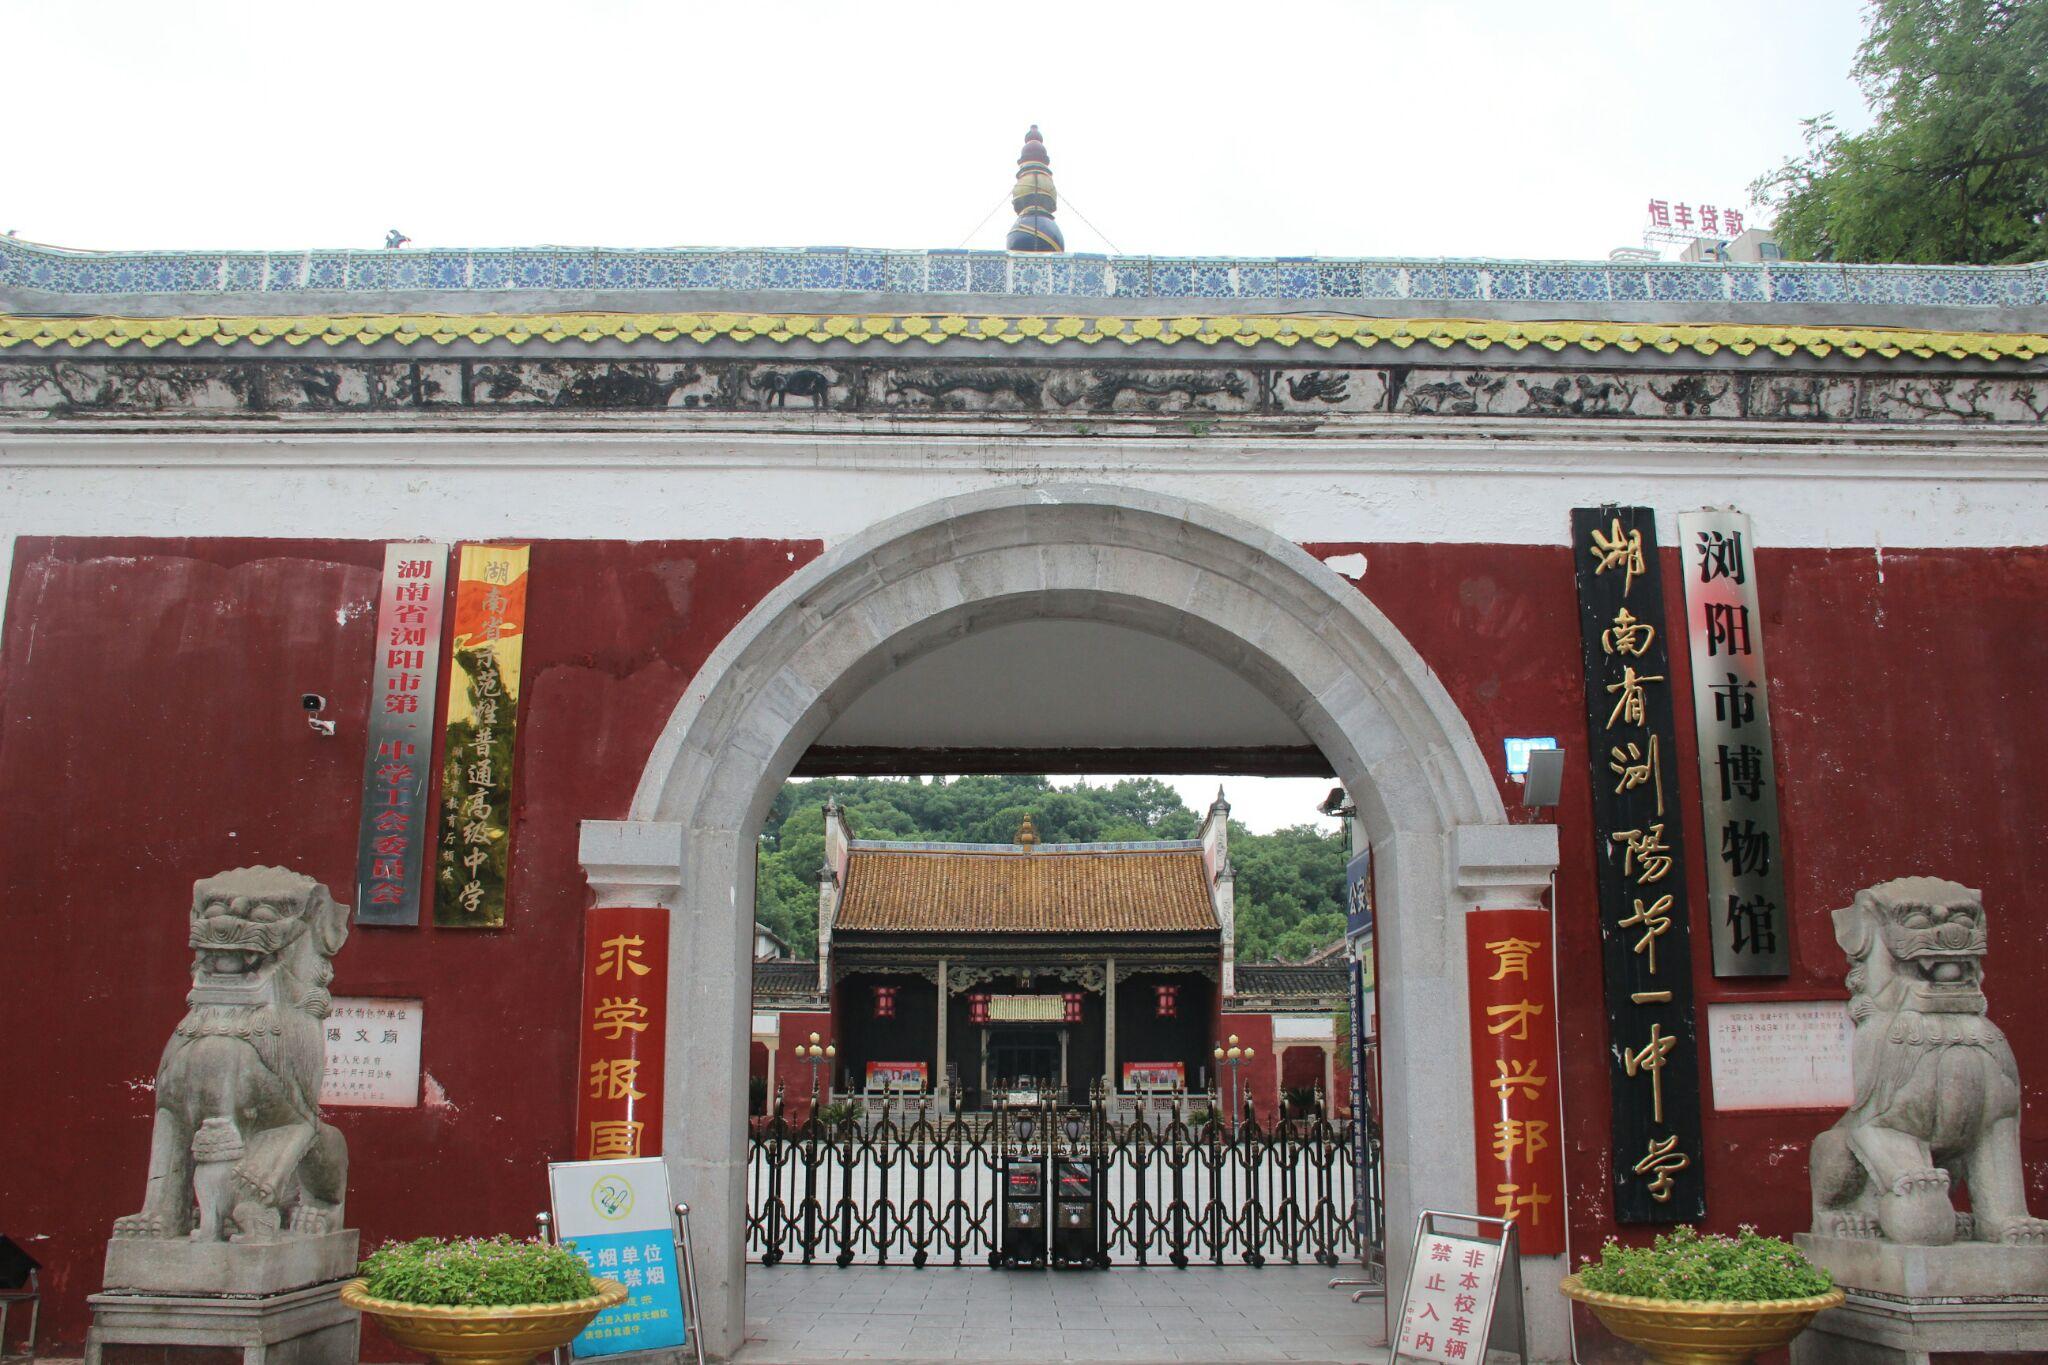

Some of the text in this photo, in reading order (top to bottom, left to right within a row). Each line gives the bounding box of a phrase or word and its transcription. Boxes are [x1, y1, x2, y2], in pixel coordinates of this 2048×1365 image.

[1648, 198, 1744, 235] 恒丰贷款
[369, 559, 433, 904] 湖南省浏阳市第一中学工会委员会
[458, 559, 510, 912] 湖南省示范性普通高级中学
[1694, 529, 1778, 957] 浏阳市博物馆
[330, 1008, 407, 1020] 级文物保护单位
[1485, 937, 1552, 1226] 育才兴邦计
[1415, 1242, 1453, 1352] 禁止入内
[1444, 1249, 1485, 1360] 非本校车辆
